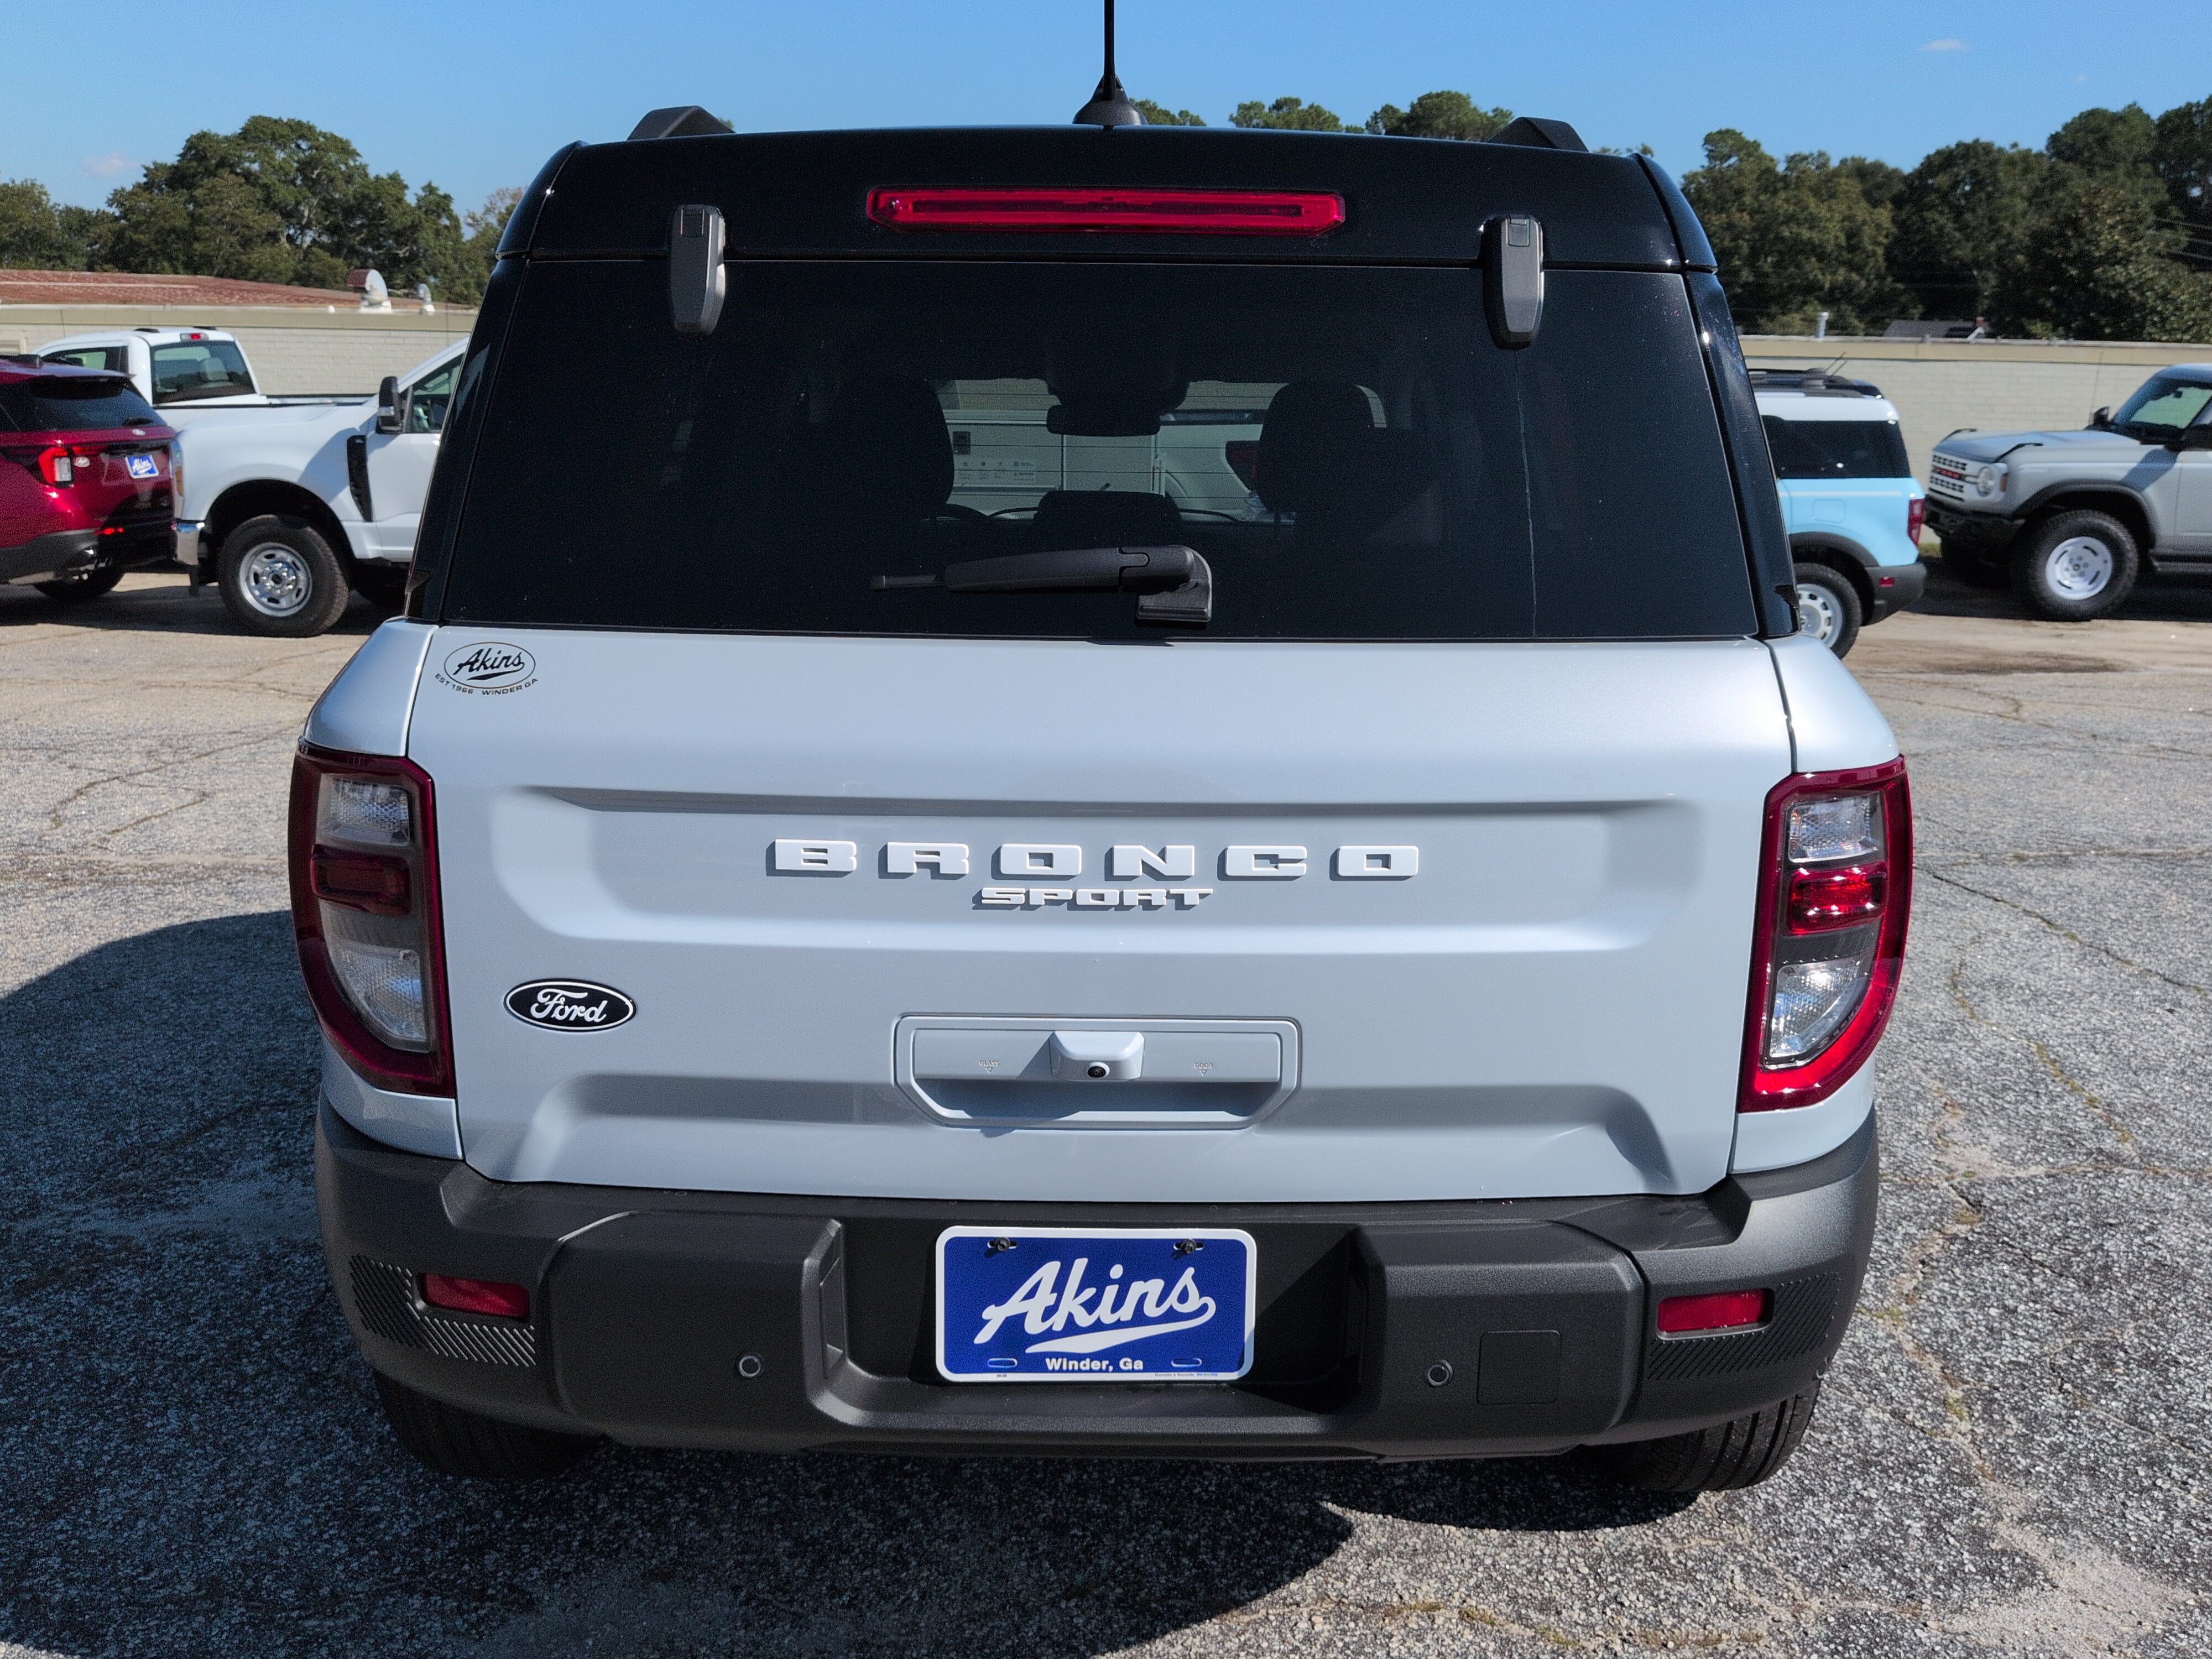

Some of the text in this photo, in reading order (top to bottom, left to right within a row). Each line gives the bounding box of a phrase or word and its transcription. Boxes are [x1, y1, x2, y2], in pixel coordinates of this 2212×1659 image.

[452, 648, 525, 675] Akins
[435, 673, 539, 695] EST 1966 WINDER GA
[774, 838, 1420, 878] BRONCO
[980, 887, 1214, 906] SPORT
[530, 988, 608, 1022] Ford
[973, 1258, 1211, 1344] Akins
[1045, 1357, 1144, 1372] Winder, Ga
